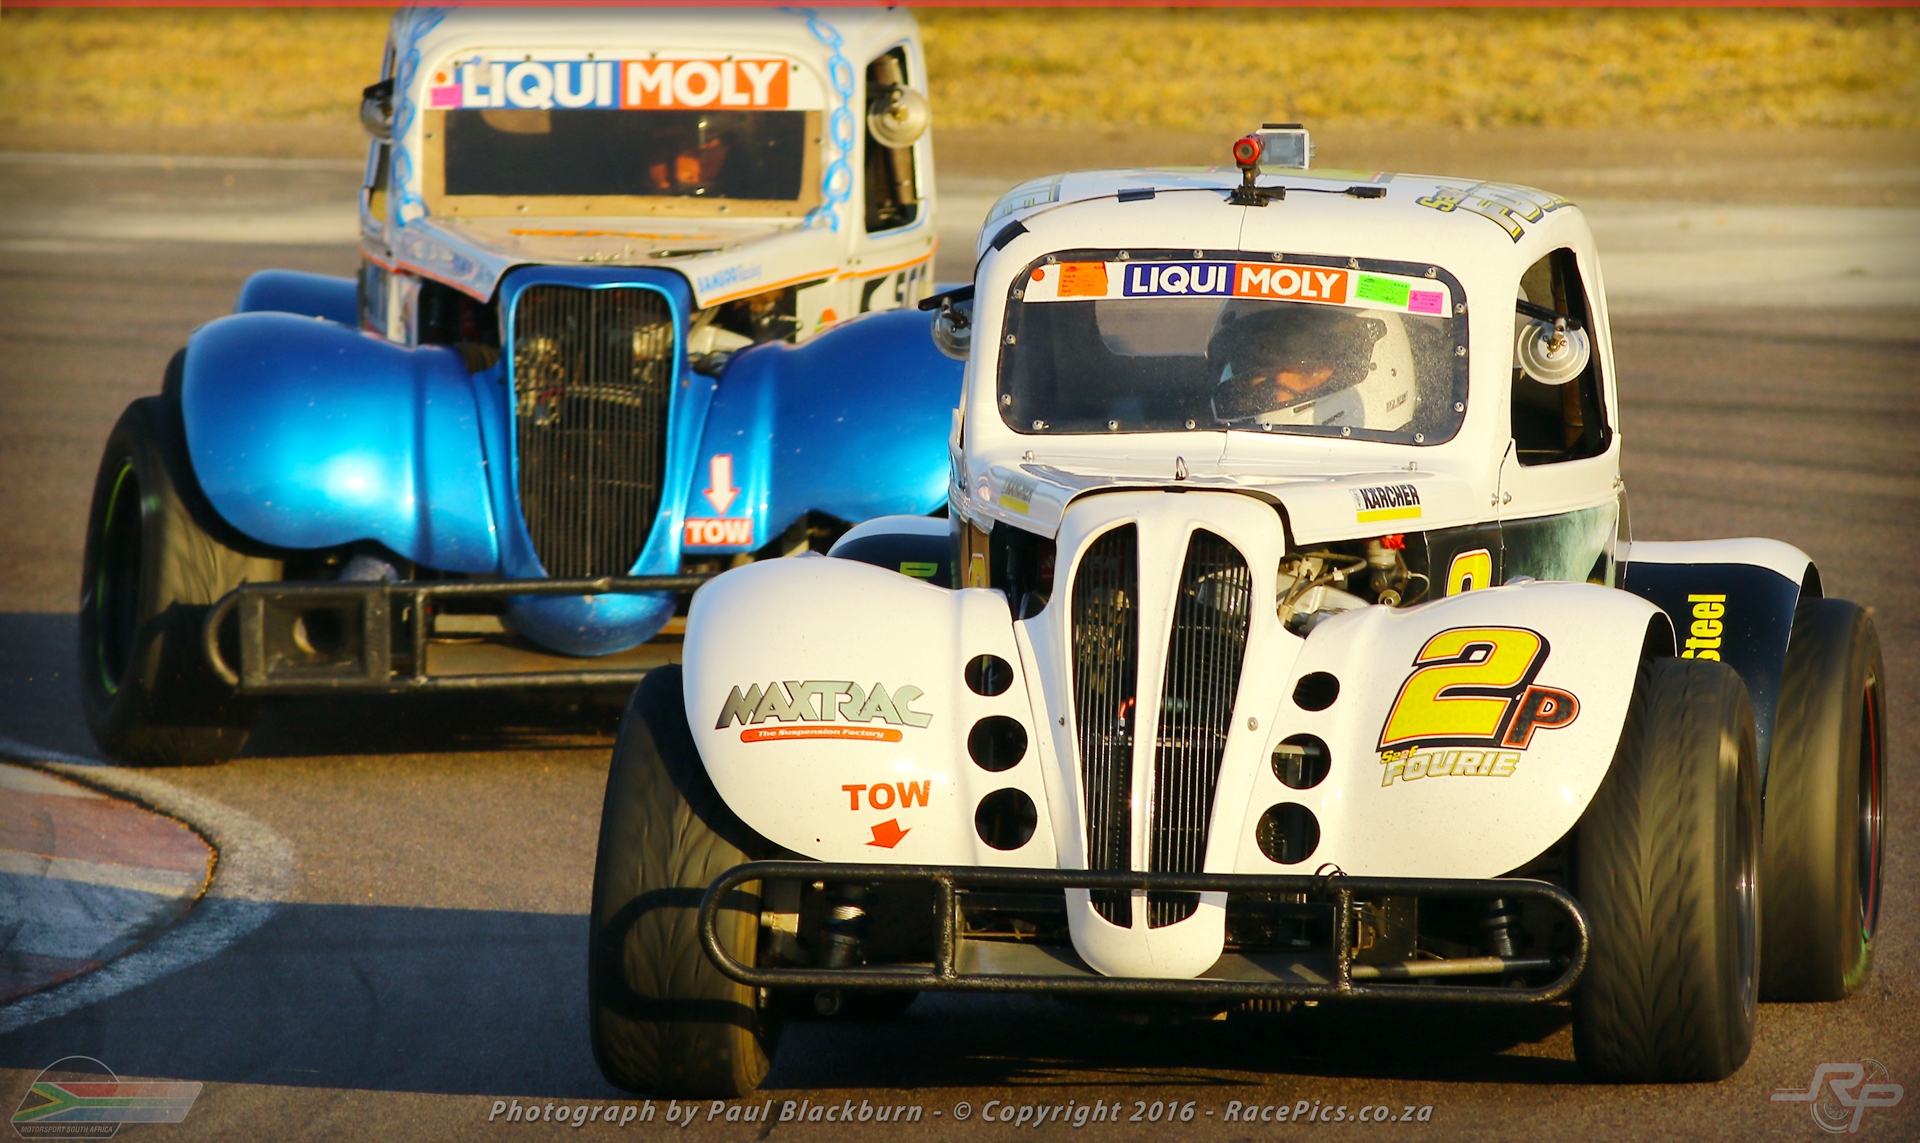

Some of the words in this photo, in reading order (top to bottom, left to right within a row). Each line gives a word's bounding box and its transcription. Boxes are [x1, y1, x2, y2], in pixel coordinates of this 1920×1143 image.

[462, 61, 613, 110] LIQUI
[627, 60, 783, 107] MOLY
[1131, 265, 1228, 294] LIQUI
[1240, 266, 1341, 299] MOLY
[686, 520, 751, 544] TOW
[715, 680, 934, 730] MAXTRAC
[778, 728, 836, 737] Suspension
[839, 730, 884, 739] Factory
[1381, 750, 1521, 787] FOURIE
[842, 780, 931, 811] TOW
